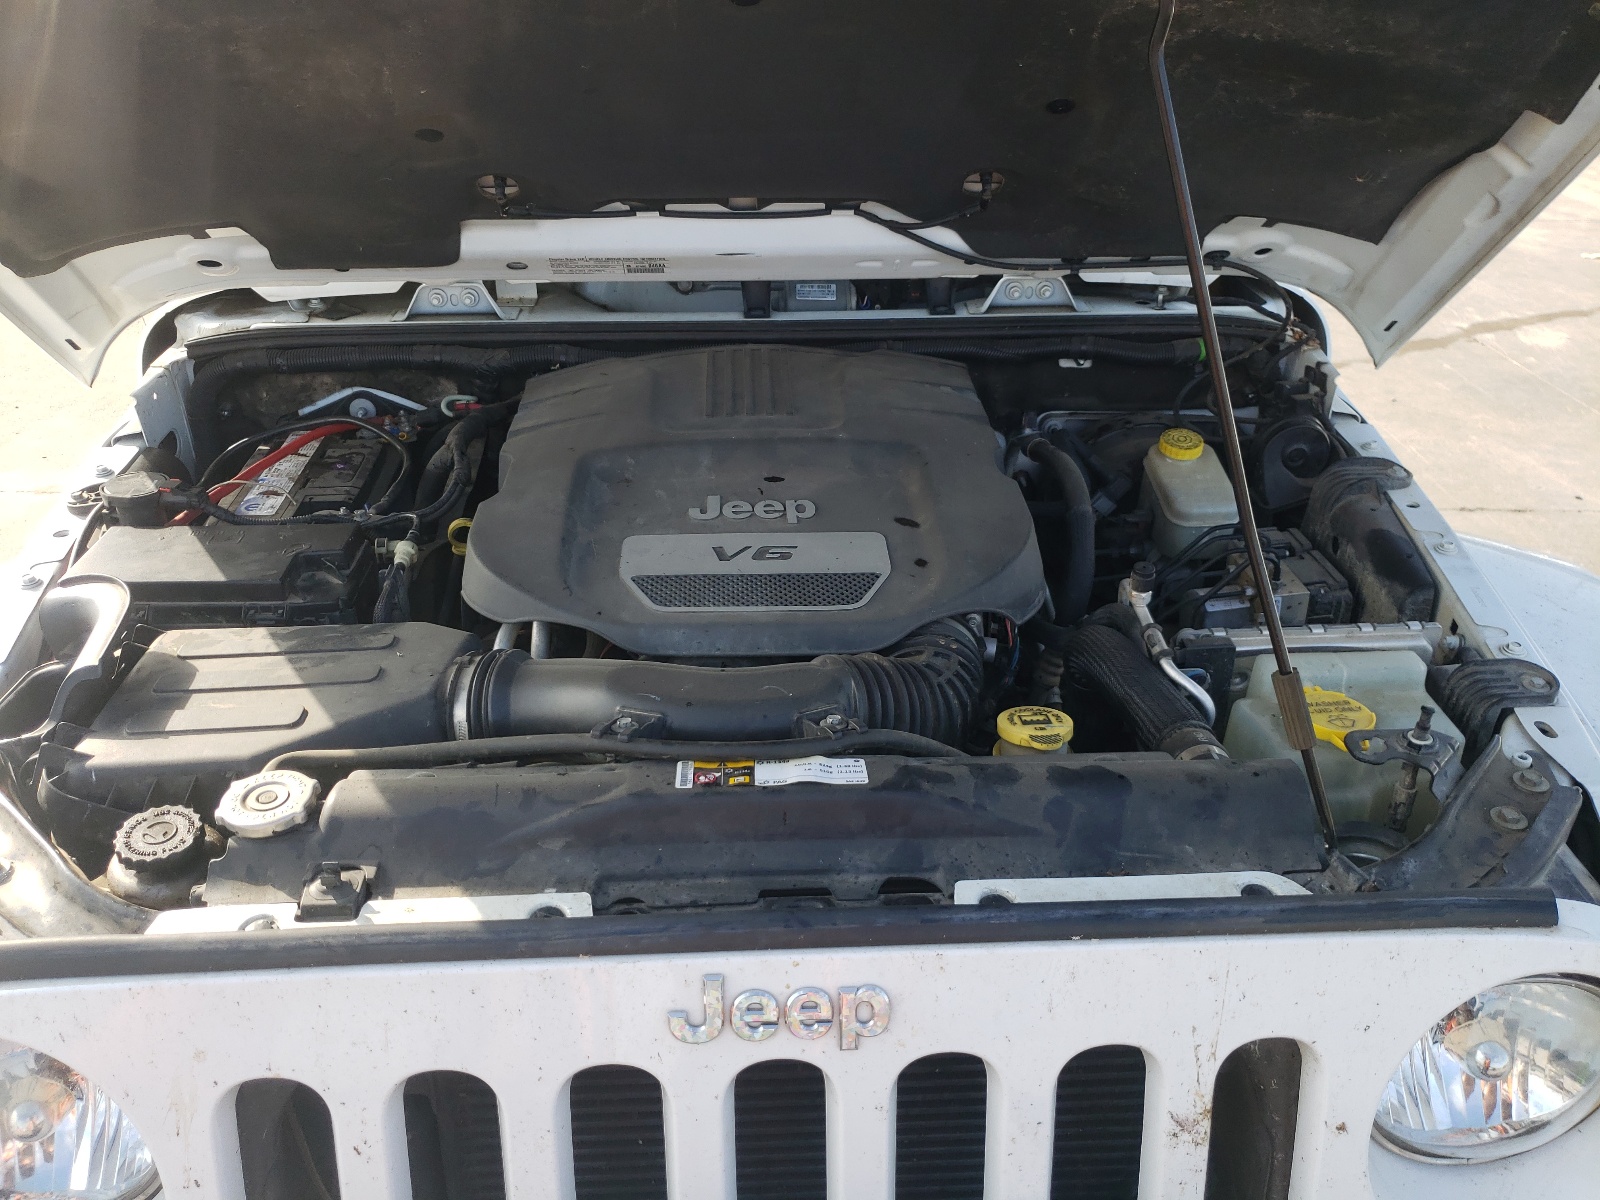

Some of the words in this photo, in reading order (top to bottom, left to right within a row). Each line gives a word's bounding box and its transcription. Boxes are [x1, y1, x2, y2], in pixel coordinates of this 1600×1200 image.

[688, 495, 816, 524] Jeep
[712, 545, 798, 561] V6
[667, 973, 891, 1051] Jeep
